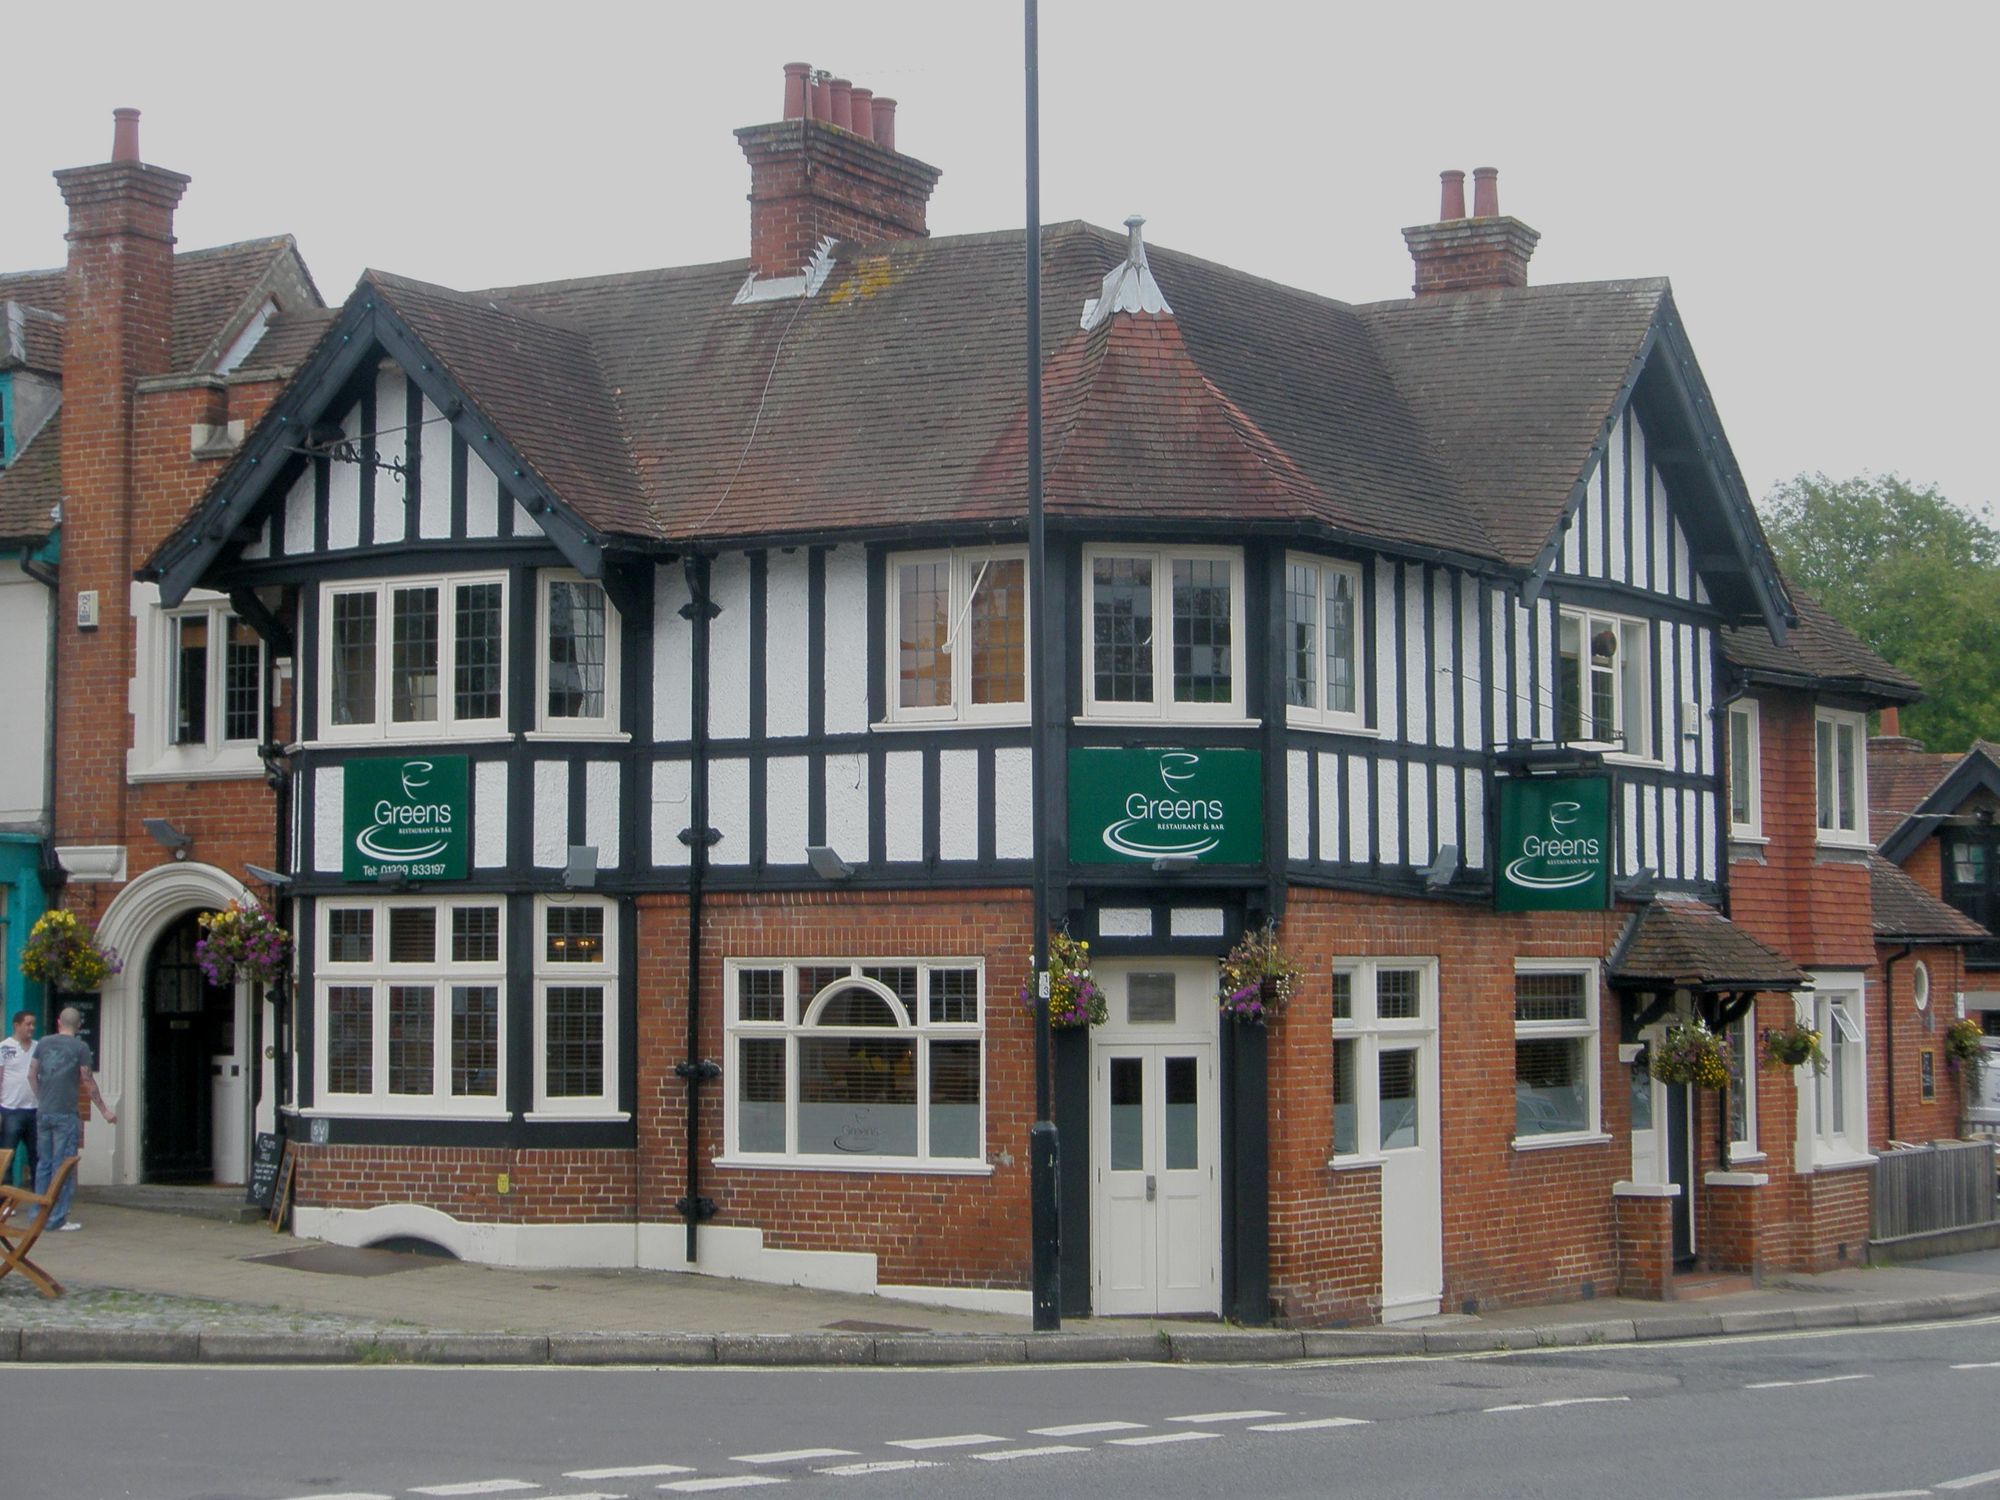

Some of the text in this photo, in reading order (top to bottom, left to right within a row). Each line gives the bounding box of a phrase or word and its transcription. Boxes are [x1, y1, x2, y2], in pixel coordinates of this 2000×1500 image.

[374, 800, 452, 825] Greens
[1125, 792, 1223, 820] Greens
[398, 827, 434, 835] RESTAURANT
[1157, 823, 1225, 831] RESTAURANT & BAR
[1523, 835, 1599, 857] Greens
[411, 863, 446, 876] 833197
